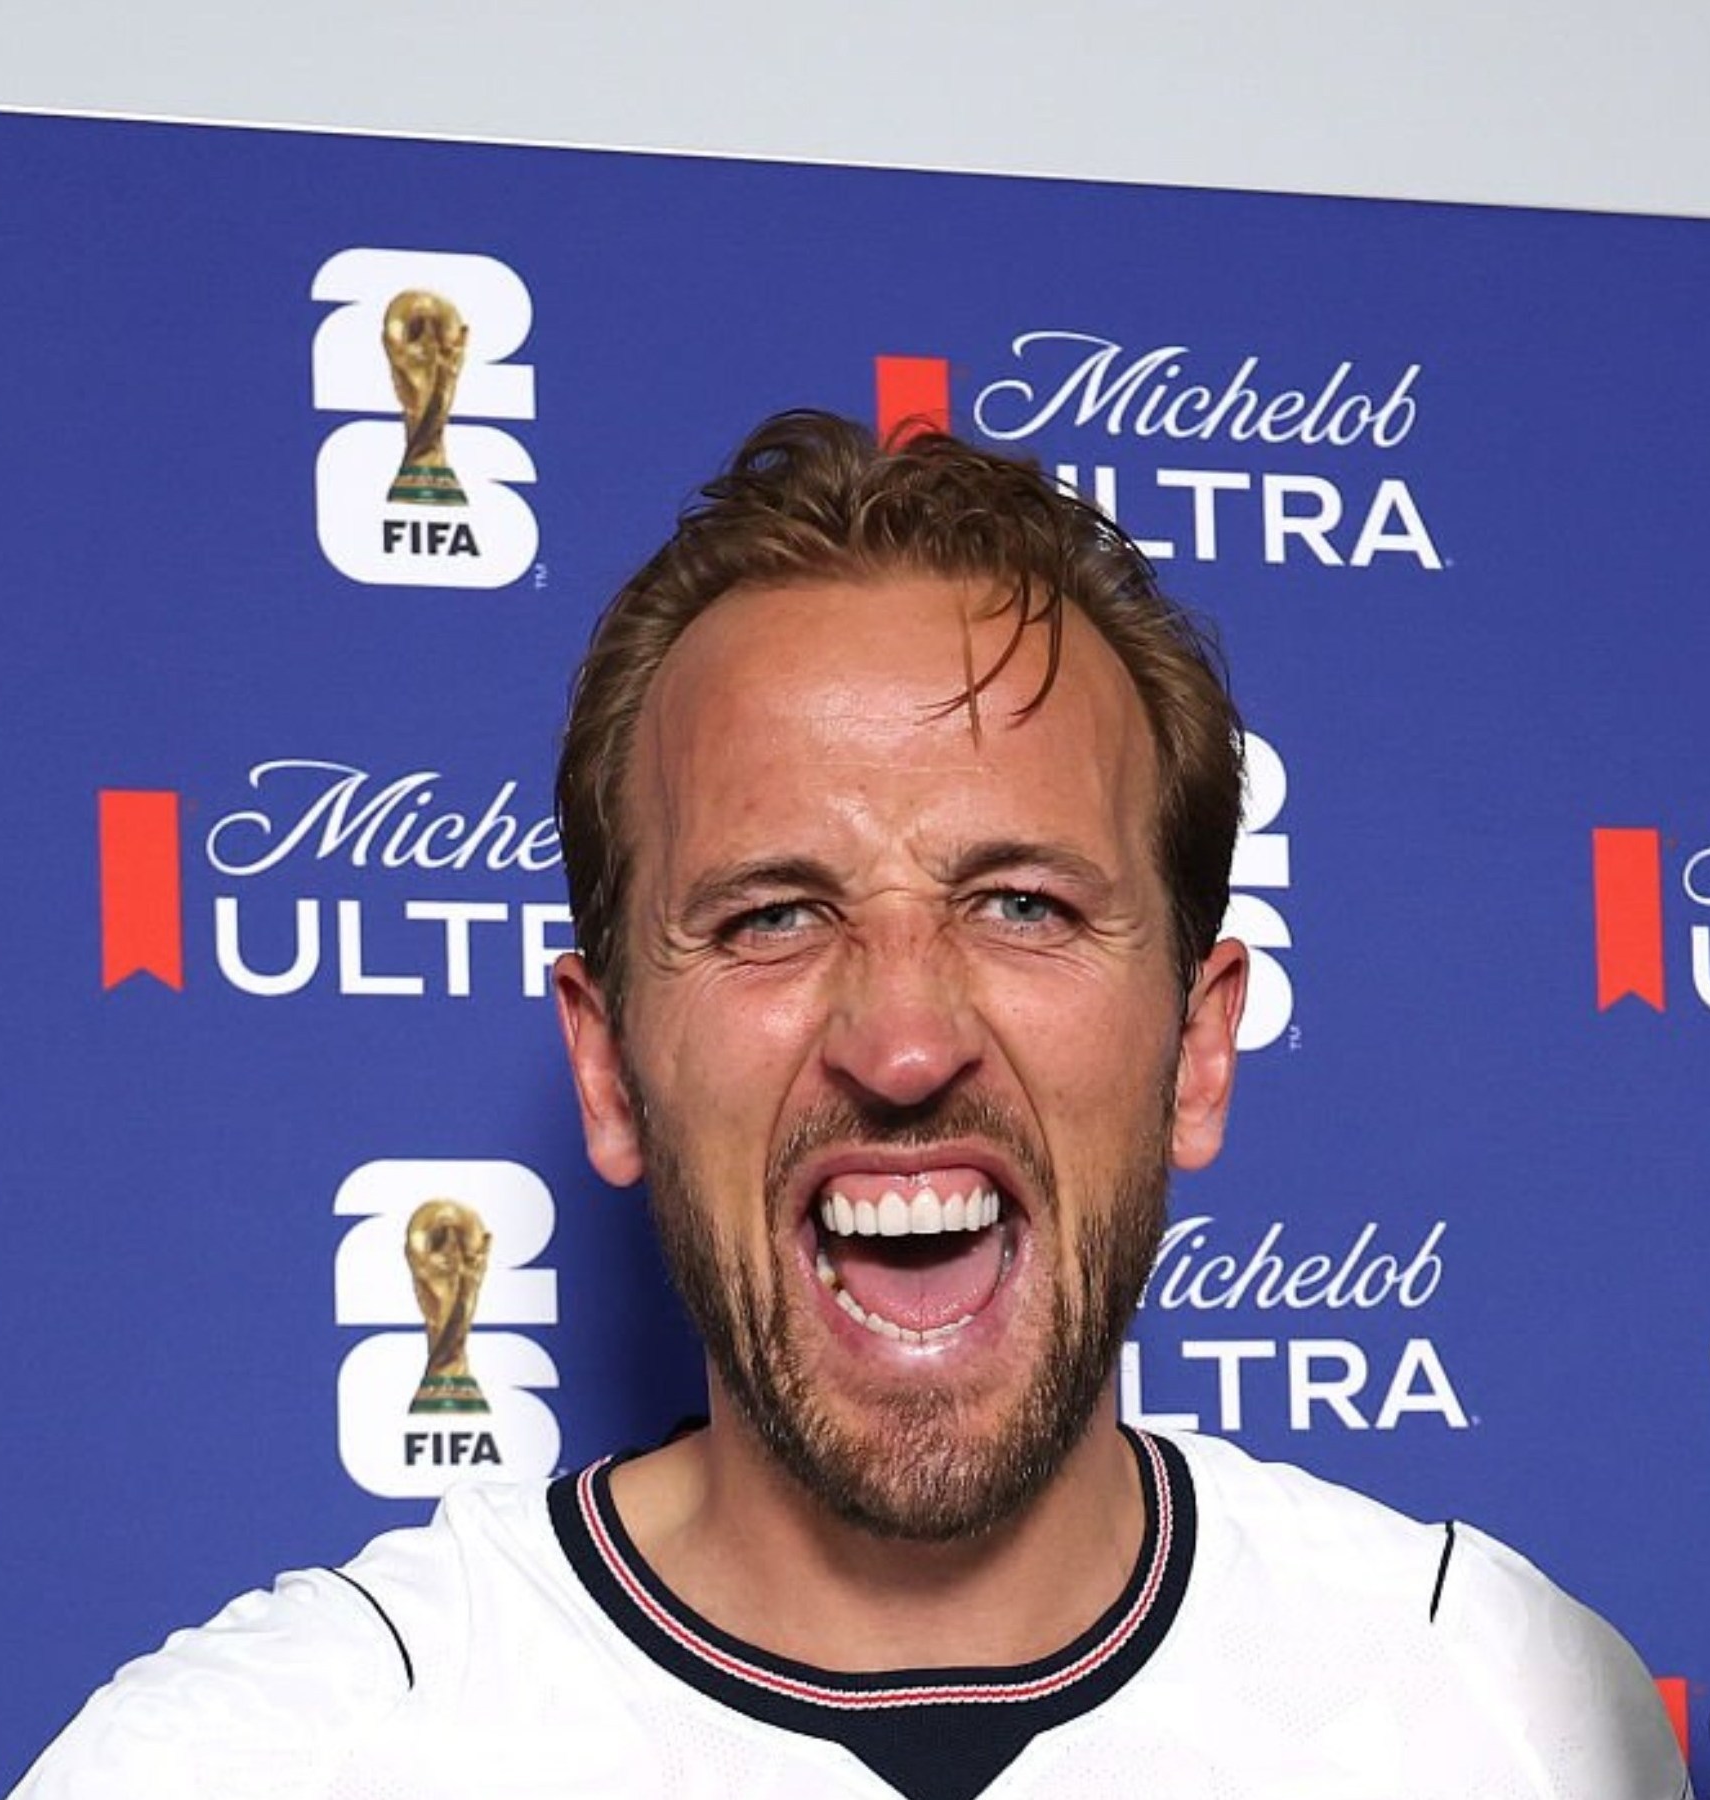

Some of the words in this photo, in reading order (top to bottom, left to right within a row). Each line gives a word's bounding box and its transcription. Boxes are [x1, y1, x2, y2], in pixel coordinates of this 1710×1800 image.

[974, 332, 1419, 447] Michelob
[384, 520, 479, 556] FIFA
[1057, 465, 1441, 569] LTRA
[207, 760, 562, 875] Miche
[1136, 1215, 1447, 1309] ichelob
[1121, 1339, 1468, 1429] LTRA
[405, 1433, 501, 1465] FIFA
